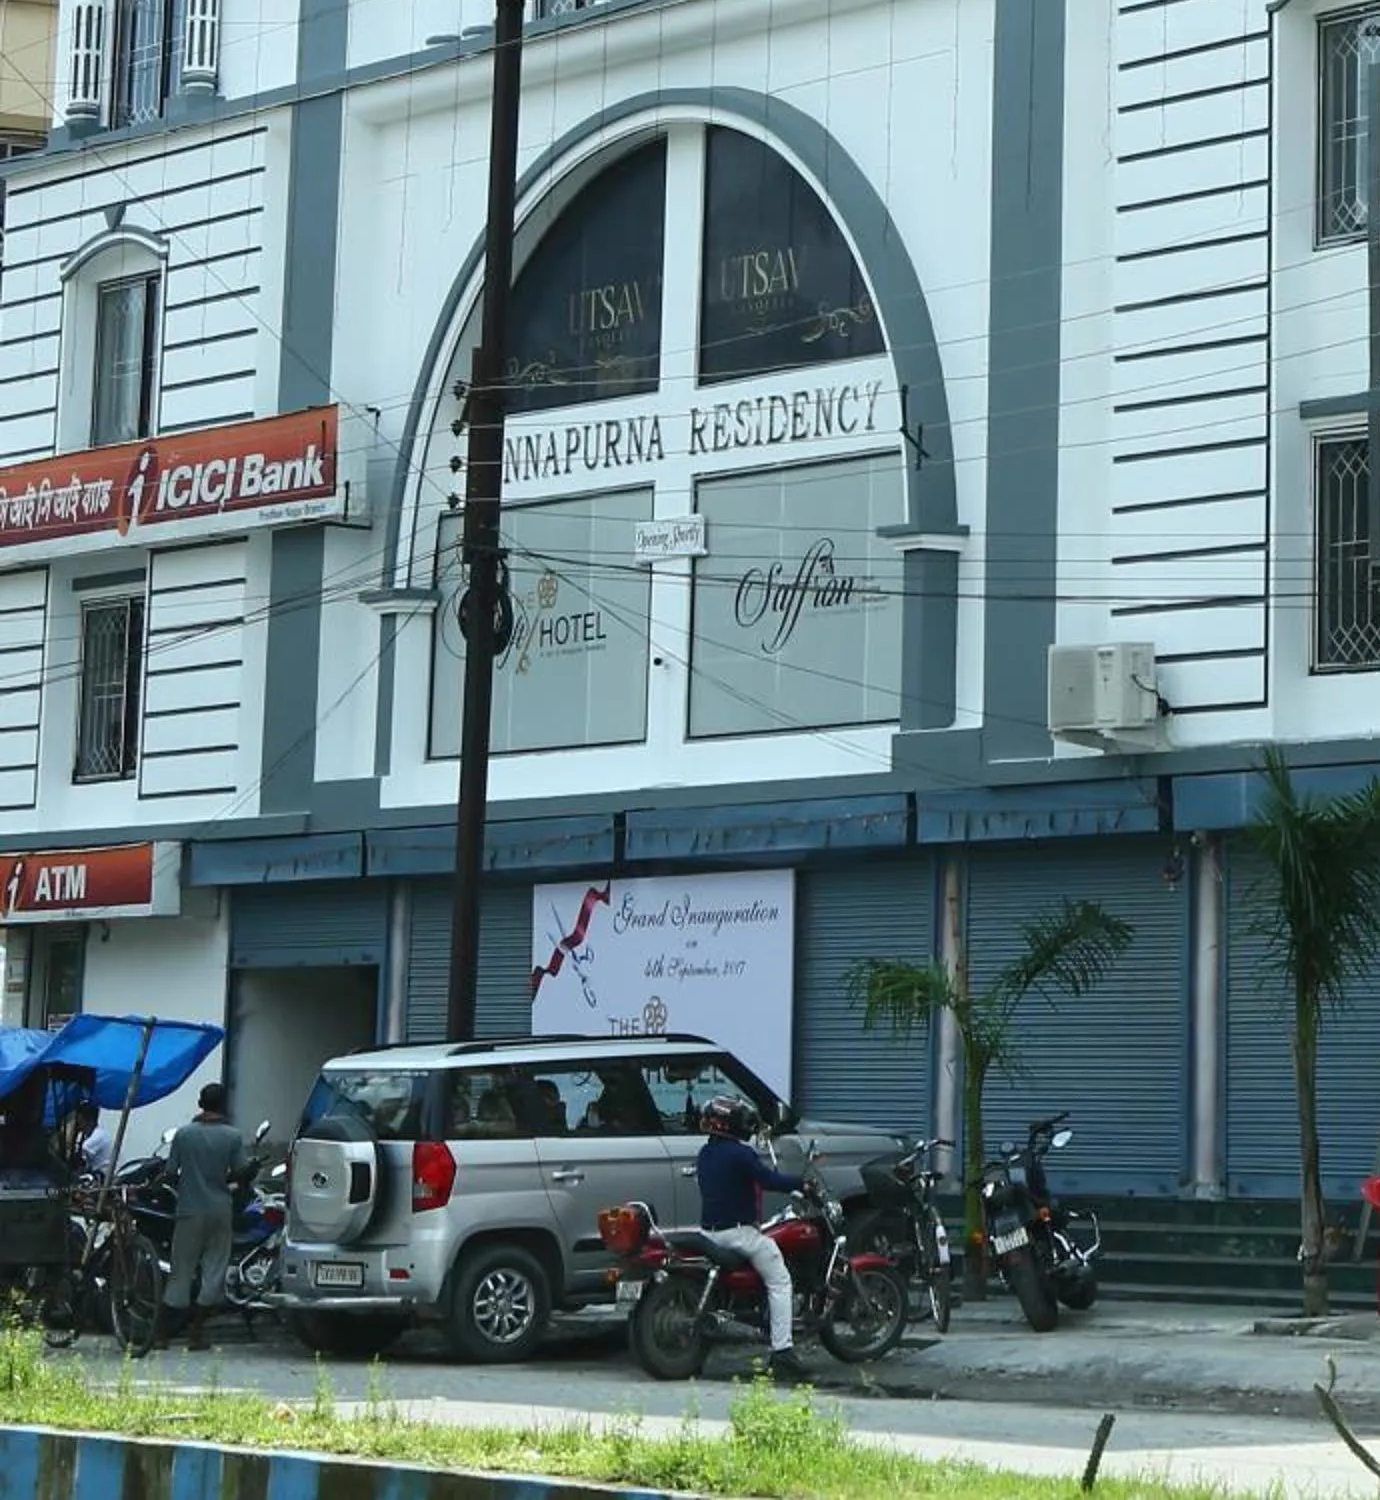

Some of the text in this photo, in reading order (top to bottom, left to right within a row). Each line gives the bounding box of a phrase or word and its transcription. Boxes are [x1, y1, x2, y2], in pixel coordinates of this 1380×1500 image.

[503, 380, 881, 485] NNAPURNA RESIDENCY
[155, 457, 237, 511] ICICI
[240, 444, 324, 498] Bank
[734, 537, 855, 656] Saffron
[539, 611, 607, 648] HOTEL
[34, 864, 87, 902] ATM
[613, 892, 779, 937] Grand Inauguration
[607, 1016, 640, 1037] THE
